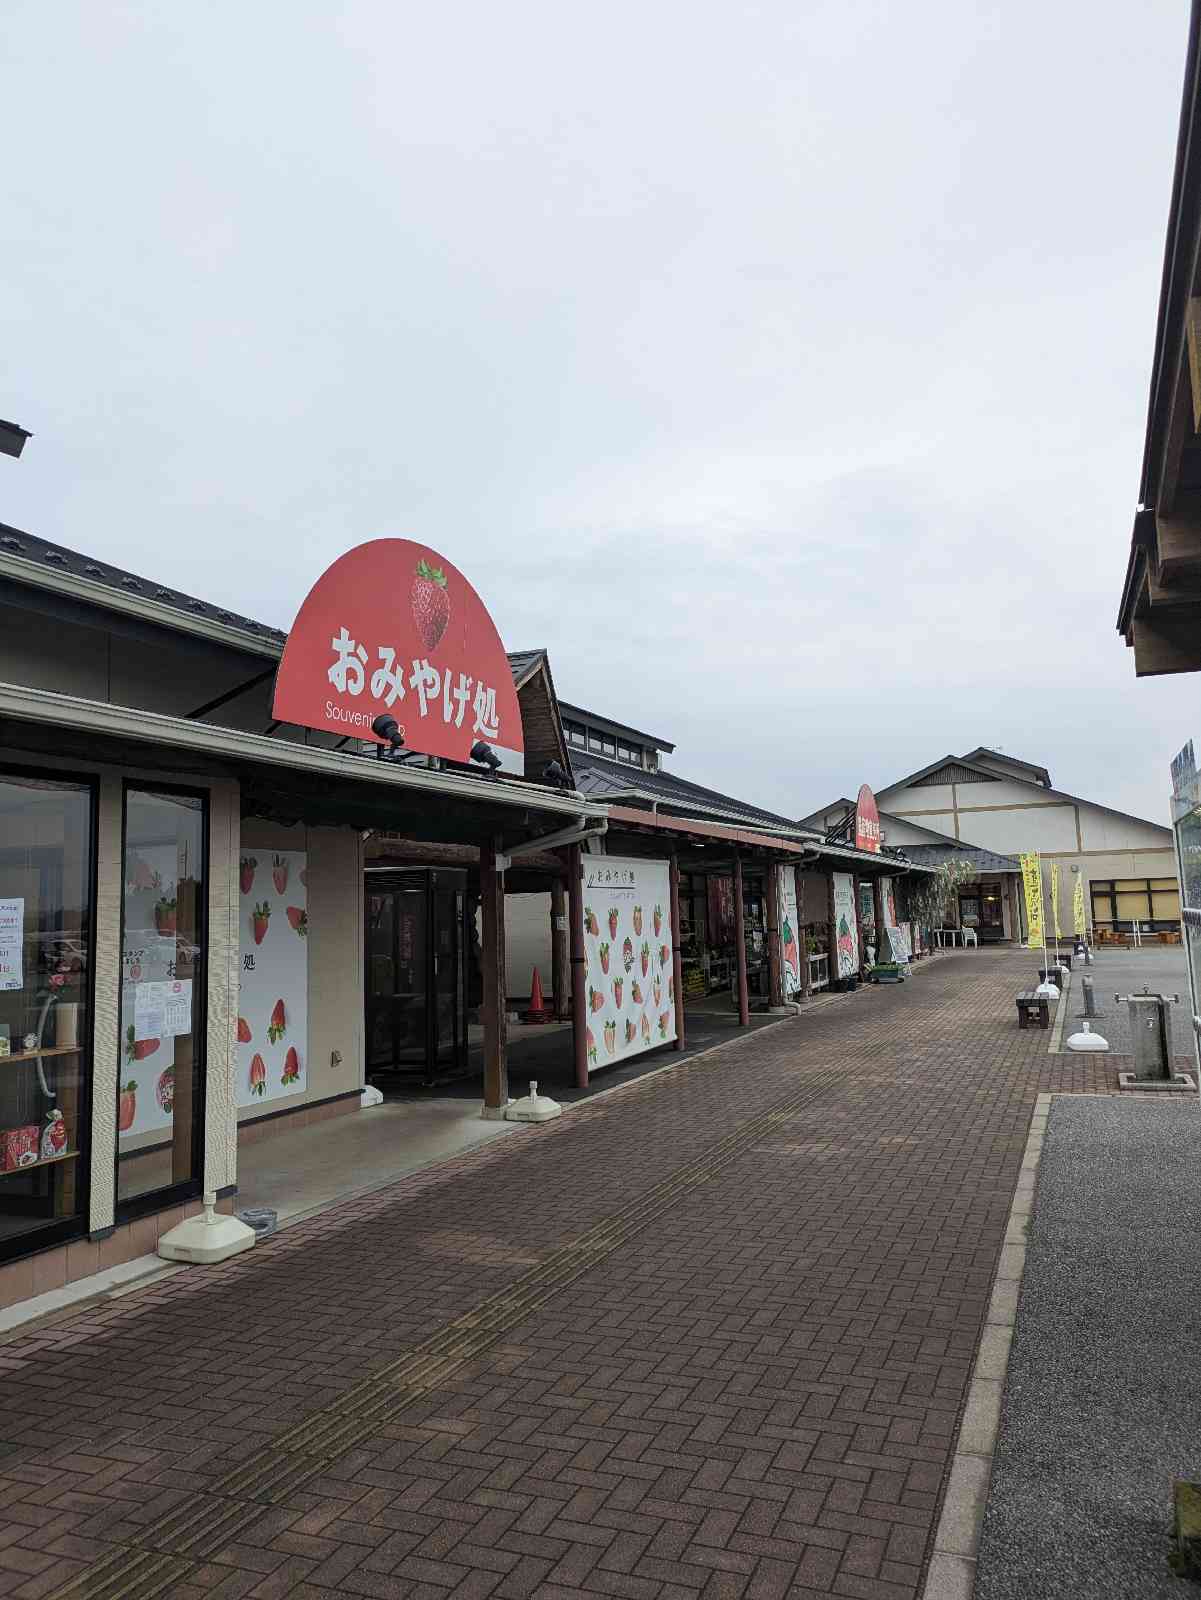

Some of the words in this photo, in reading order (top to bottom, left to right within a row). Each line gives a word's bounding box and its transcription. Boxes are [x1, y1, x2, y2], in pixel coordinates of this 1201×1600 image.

[327, 627, 501, 739] おみやげ処
[325, 700, 376, 728] Souveni
[243, 953, 256, 971] 処
